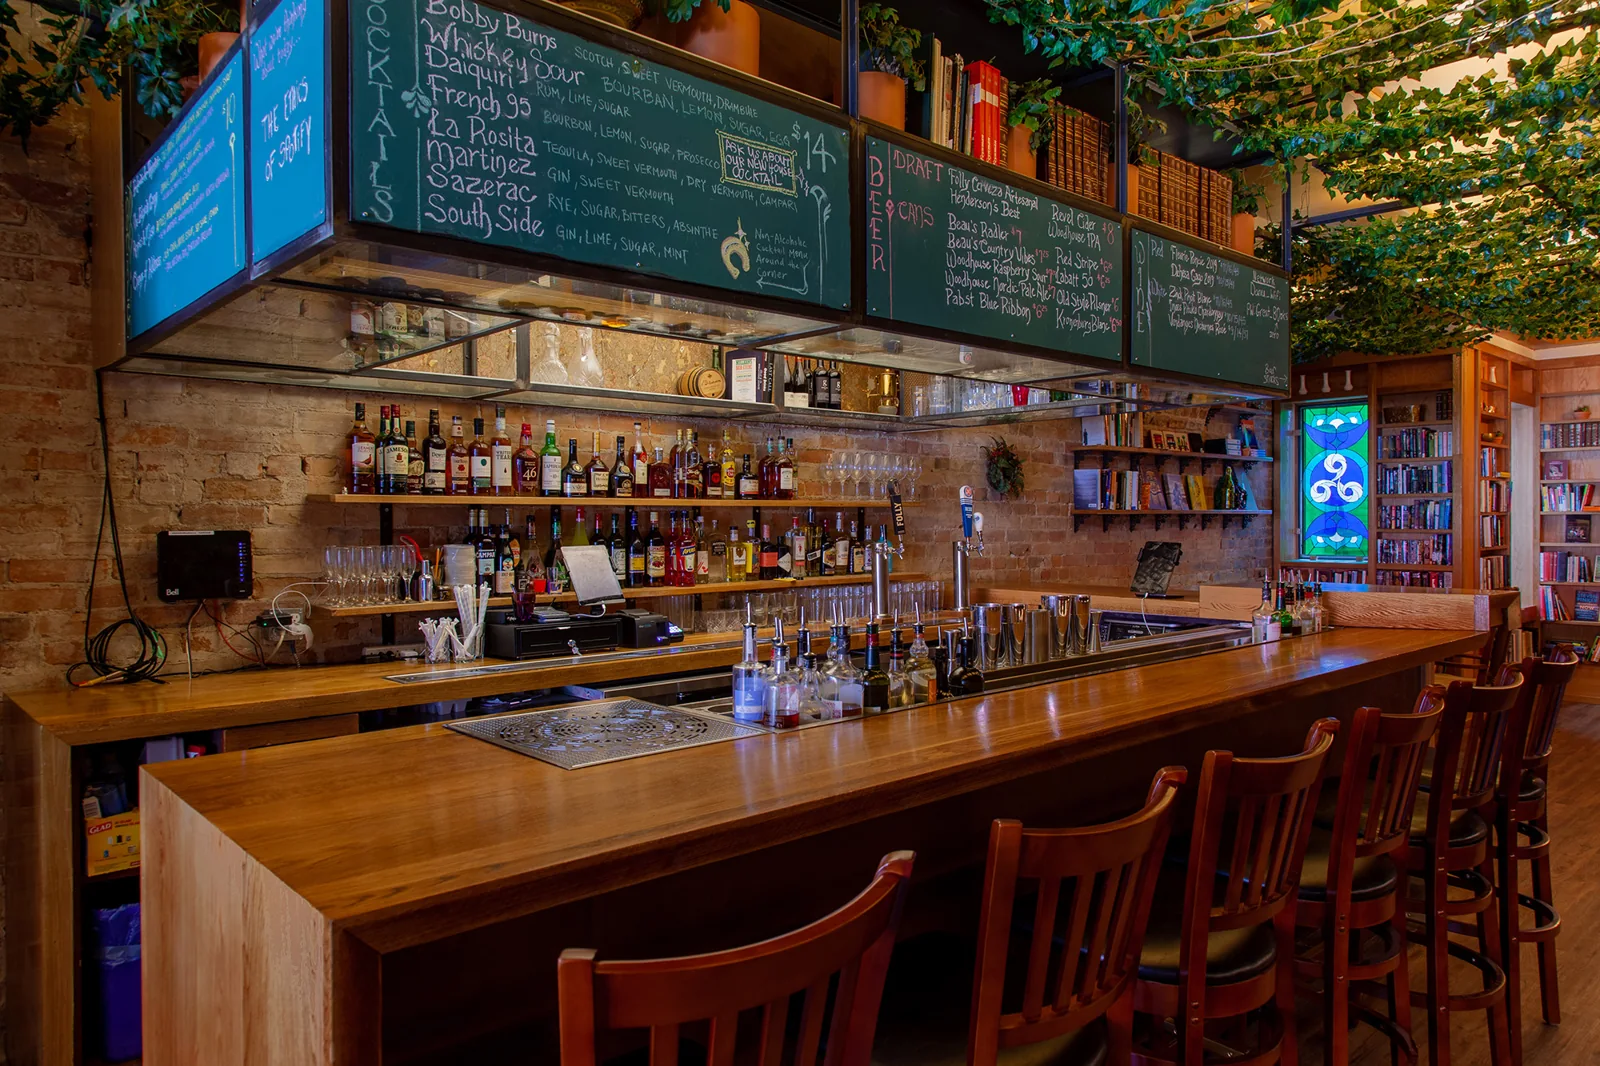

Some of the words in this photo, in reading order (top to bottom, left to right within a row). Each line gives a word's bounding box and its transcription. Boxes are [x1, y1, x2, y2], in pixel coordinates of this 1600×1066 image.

[425, 0, 499, 35] Bobby
[503, 13, 557, 51] Burns
[420, 18, 528, 84] Whiskey
[530, 48, 585, 85] Sour
[424, 44, 514, 90] Daiquiri
[598, 98, 632, 118] SUGAR
[622, 61, 660, 84] SWEET
[261, 104, 279, 142] THE
[366, 0, 397, 222] OCKTAILS
[426, 74, 501, 121] French
[507, 94, 533, 119] 95
[676, 149, 721, 170] PROSECCO
[264, 149, 276, 181] OF
[278, 115, 311, 168] SPOTIFY
[426, 108, 461, 138] La
[467, 115, 539, 157] Rosita
[597, 152, 631, 171] SWEET
[686, 175, 707, 193] DRY
[759, 193, 799, 213] CAMPARI
[725, 139, 745, 155] ASK
[747, 147, 760, 159] US
[762, 150, 791, 168] ABOUT
[769, 131, 791, 148] EGG
[791, 121, 837, 173] $14
[725, 154, 745, 168] OUR
[747, 158, 767, 171] NEW
[768, 160, 793, 177] HOUSE
[731, 165, 783, 187] COCKTAIL
[893, 150, 944, 182] DRAFT
[947, 168, 971, 192] Folly
[426, 163, 538, 203] Sazerac
[672, 219, 720, 240] ABSINTHE
[579, 174, 622, 192] SWEET
[624, 184, 675, 206] VERMOUTH
[949, 187, 999, 216] Henderson's
[1000, 200, 1021, 220] Best
[424, 193, 493, 239] South
[495, 203, 545, 238] Side
[663, 246, 690, 265] MINT
[869, 155, 886, 272] BEER
[897, 200, 935, 229] CANS
[947, 212, 978, 234] Beau's
[979, 221, 1010, 242] Radler
[1051, 203, 1074, 226] Revel
[1076, 212, 1097, 232] Cider
[946, 231, 979, 251] Beau's
[979, 239, 1015, 264] Country
[1047, 220, 1086, 245] Woodhouse
[1087, 232, 1101, 252] IPA
[1150, 239, 1164, 258] Red
[755, 254, 785, 267] Around
[756, 267, 788, 280] Corner
[945, 248, 992, 274] Woodhouse
[1054, 246, 1073, 267] Red
[1074, 251, 1099, 274] Stripe
[944, 268, 991, 291] Woodhouse
[1036, 281, 1052, 303] Ale
[1054, 265, 1079, 288] Labatt
[1081, 272, 1094, 288] 50
[944, 287, 975, 308] Pabst
[979, 291, 1000, 310] Blue
[1000, 296, 1032, 325] Ribbon
[1056, 289, 1070, 306] Old
[523, 467, 537, 481] 46
[896, 502, 904, 527] FOLLY
[166, 588, 180, 596] Bell
[89, 822, 112, 835] GLAD
